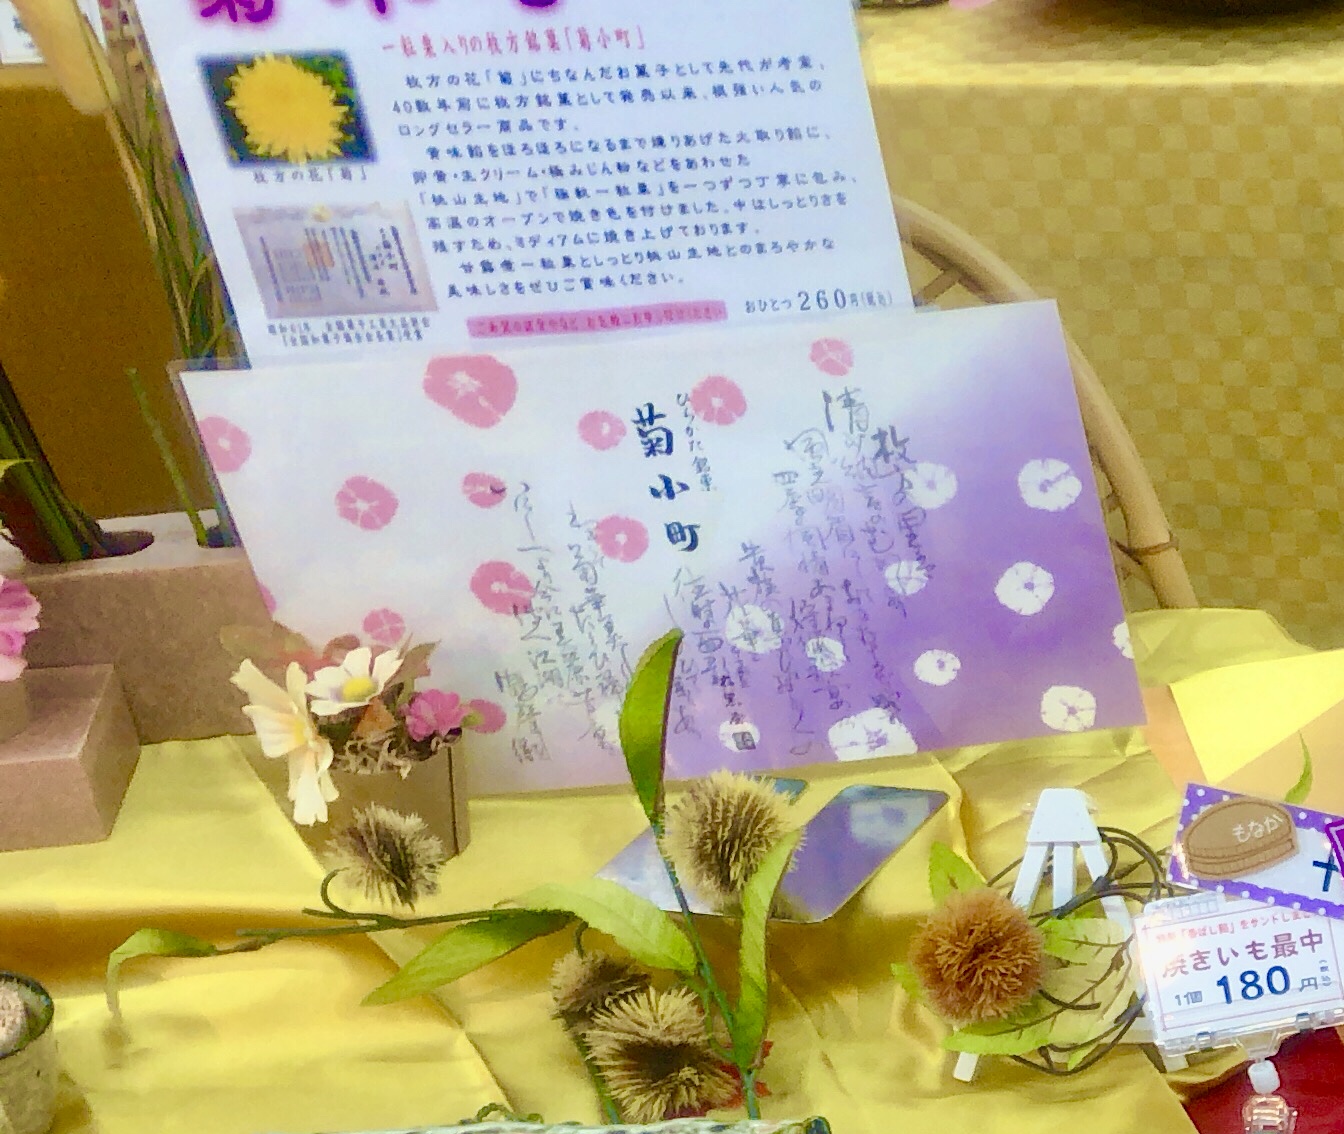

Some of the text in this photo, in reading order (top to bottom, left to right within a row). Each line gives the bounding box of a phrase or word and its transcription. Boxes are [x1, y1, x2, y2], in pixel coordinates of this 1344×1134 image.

[632, 403, 702, 552] 菊小町
[1231, 813, 1284, 844] もなか
[1163, 928, 1323, 979] 焼きいも最中
[1174, 990, 1203, 1006] 1個
